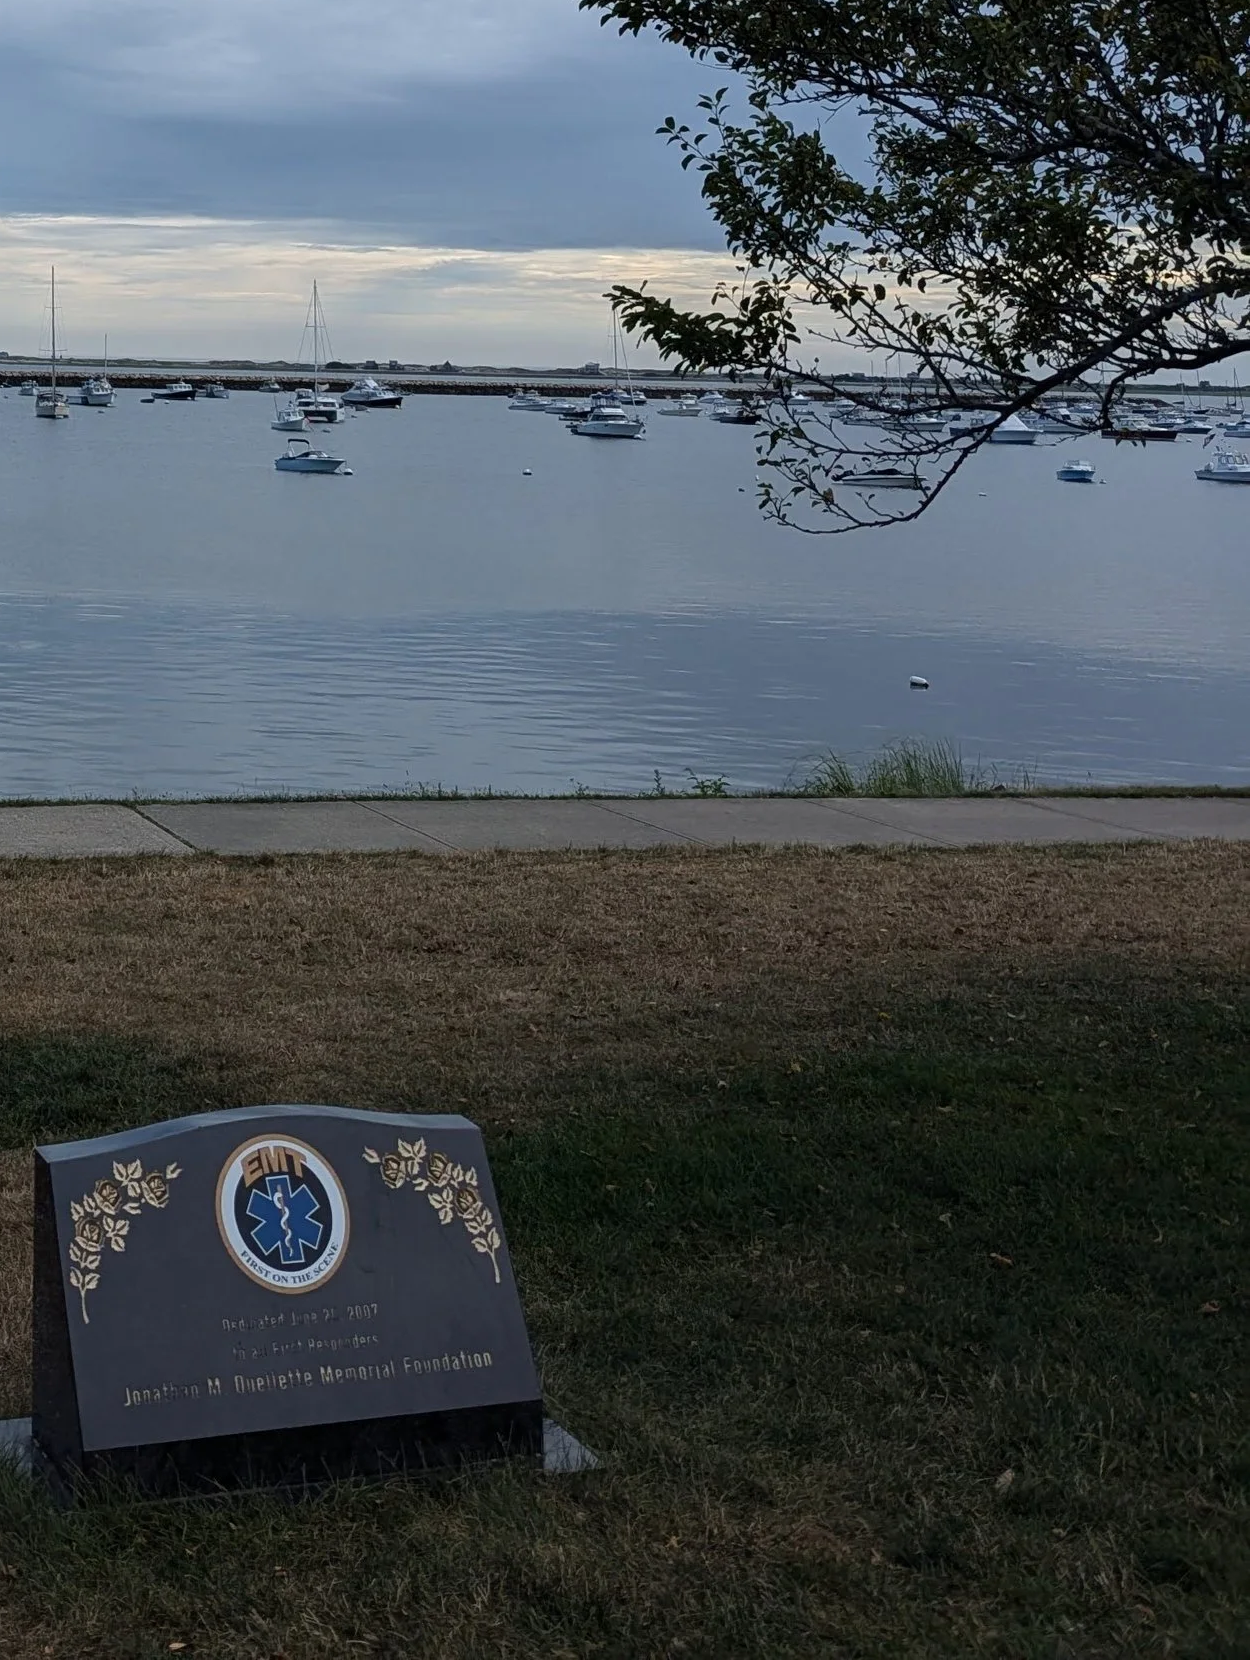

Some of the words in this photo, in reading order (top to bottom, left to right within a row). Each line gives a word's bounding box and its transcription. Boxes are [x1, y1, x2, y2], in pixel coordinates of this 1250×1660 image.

[241, 1145, 307, 1188] EMT
[240, 1250, 272, 1278] FIRST
[272, 1273, 289, 1284] ON
[290, 1272, 313, 1285] THE
[313, 1241, 339, 1277] SCENE
[347, 1303, 378, 1320] 2007
[320, 1360, 396, 1385] Memorial
[403, 1350, 493, 1374] Foundation
